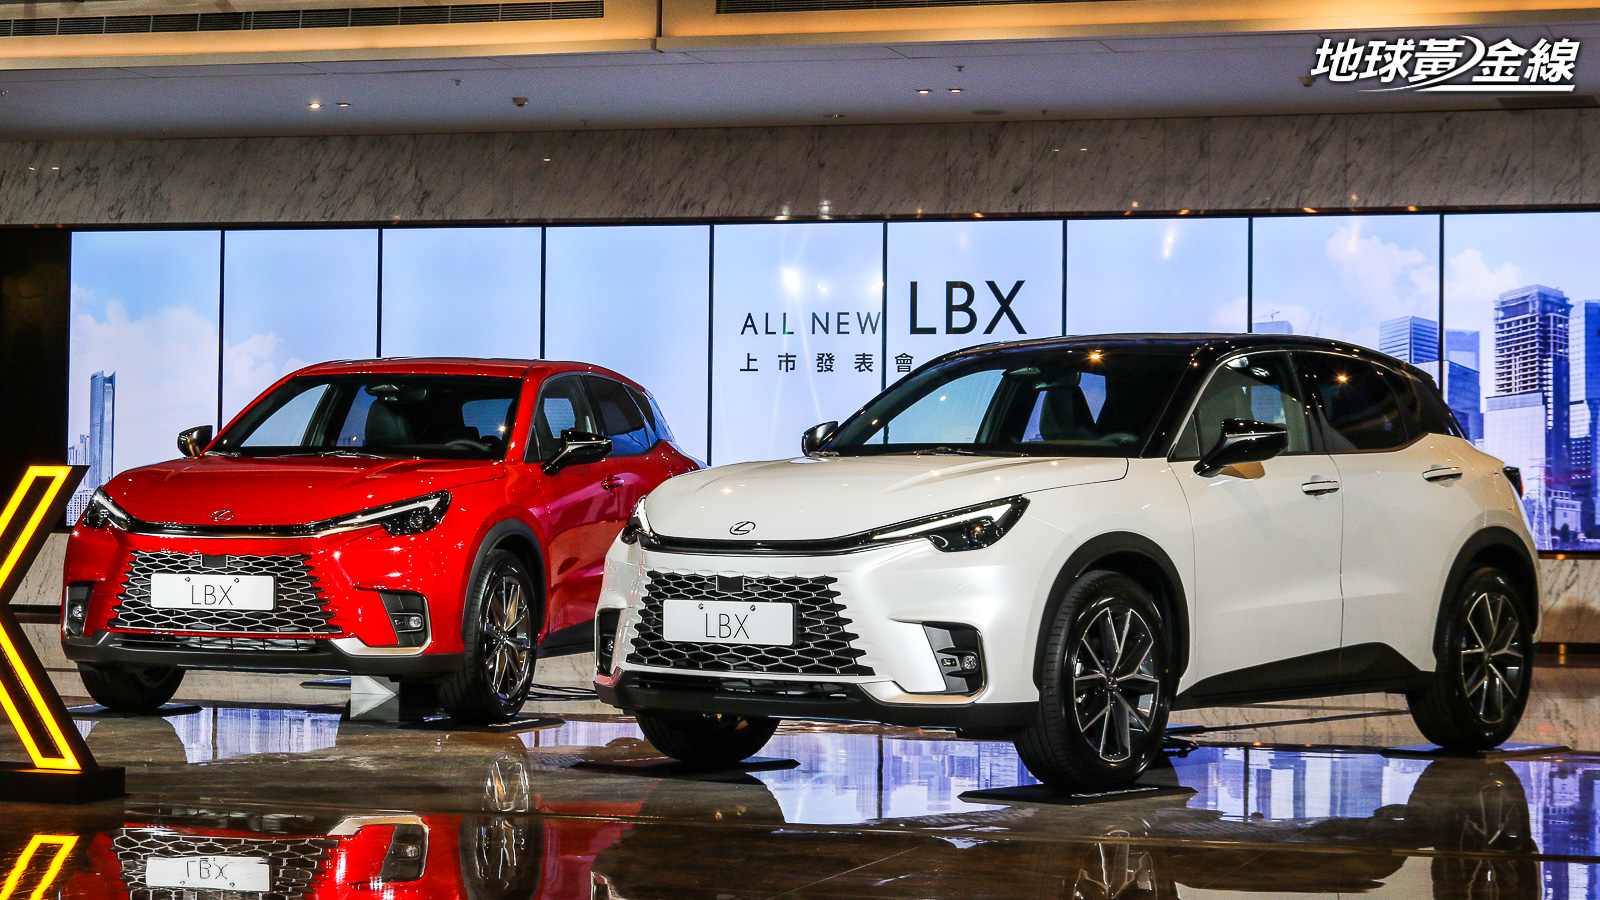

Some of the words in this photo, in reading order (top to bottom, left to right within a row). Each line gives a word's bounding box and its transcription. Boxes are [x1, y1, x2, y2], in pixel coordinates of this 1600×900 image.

[740, 312, 794, 335] ALL
[811, 311, 881, 335] NEW
[909, 280, 1028, 335] LBX
[739, 352, 914, 373] 上市發表會
[191, 584, 234, 606] LBX
[705, 613, 750, 640] LBX
